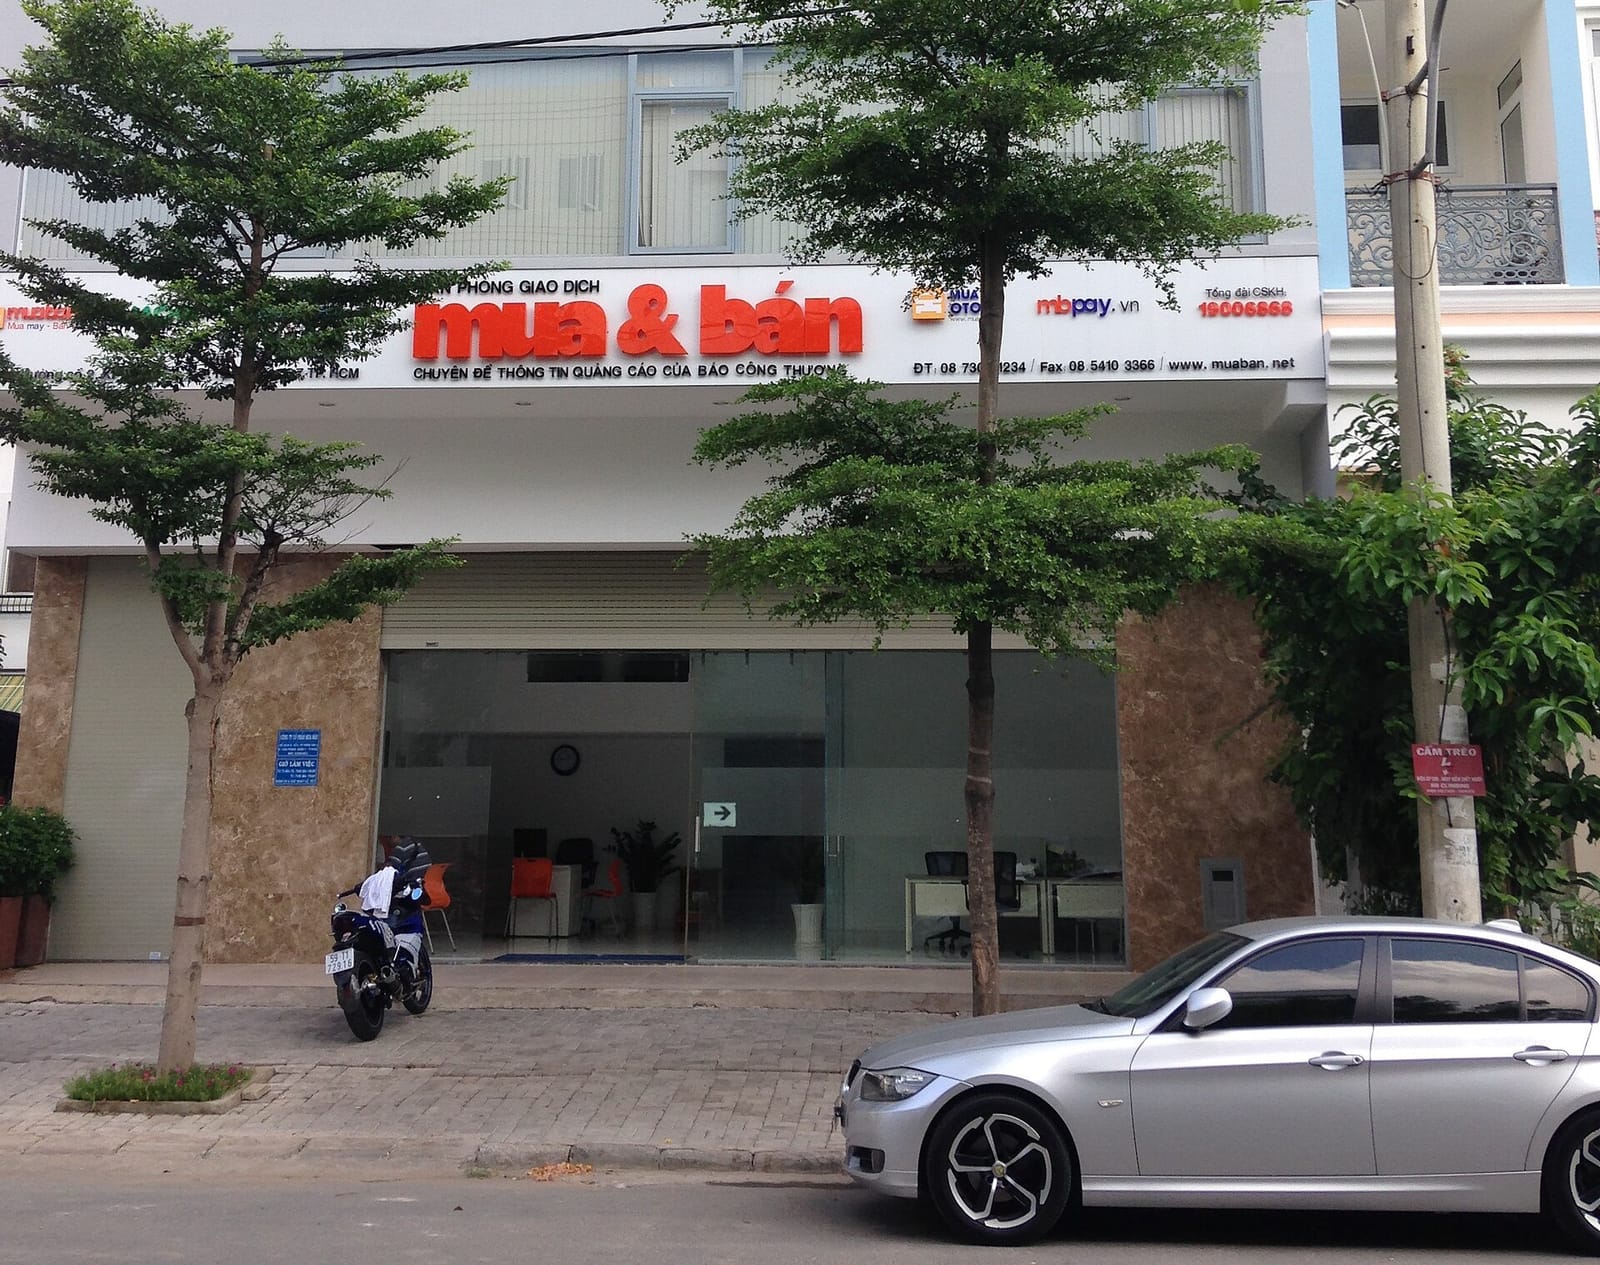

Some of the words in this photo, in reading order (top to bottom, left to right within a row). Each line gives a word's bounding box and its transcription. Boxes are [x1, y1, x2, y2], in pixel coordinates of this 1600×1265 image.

[519, 280, 558, 294] GIAO
[563, 279, 600, 296] DỊCH
[413, 301, 606, 358] mua
[616, 283, 688, 356] &
[700, 280, 863, 354] bán
[413, 364, 469, 379] CHUYÊN
[473, 363, 493, 378] ĐỀ
[498, 365, 545, 379] THÔNG
[550, 366, 569, 378] TIN
[573, 363, 622, 378] QUẢNG
[628, 364, 657, 377] CÁO
[663, 362, 691, 377] CỦA
[698, 363, 729, 376] BÁO
[736, 361, 777, 376] CÔNG
[1124, 359, 1156, 371] 3366
